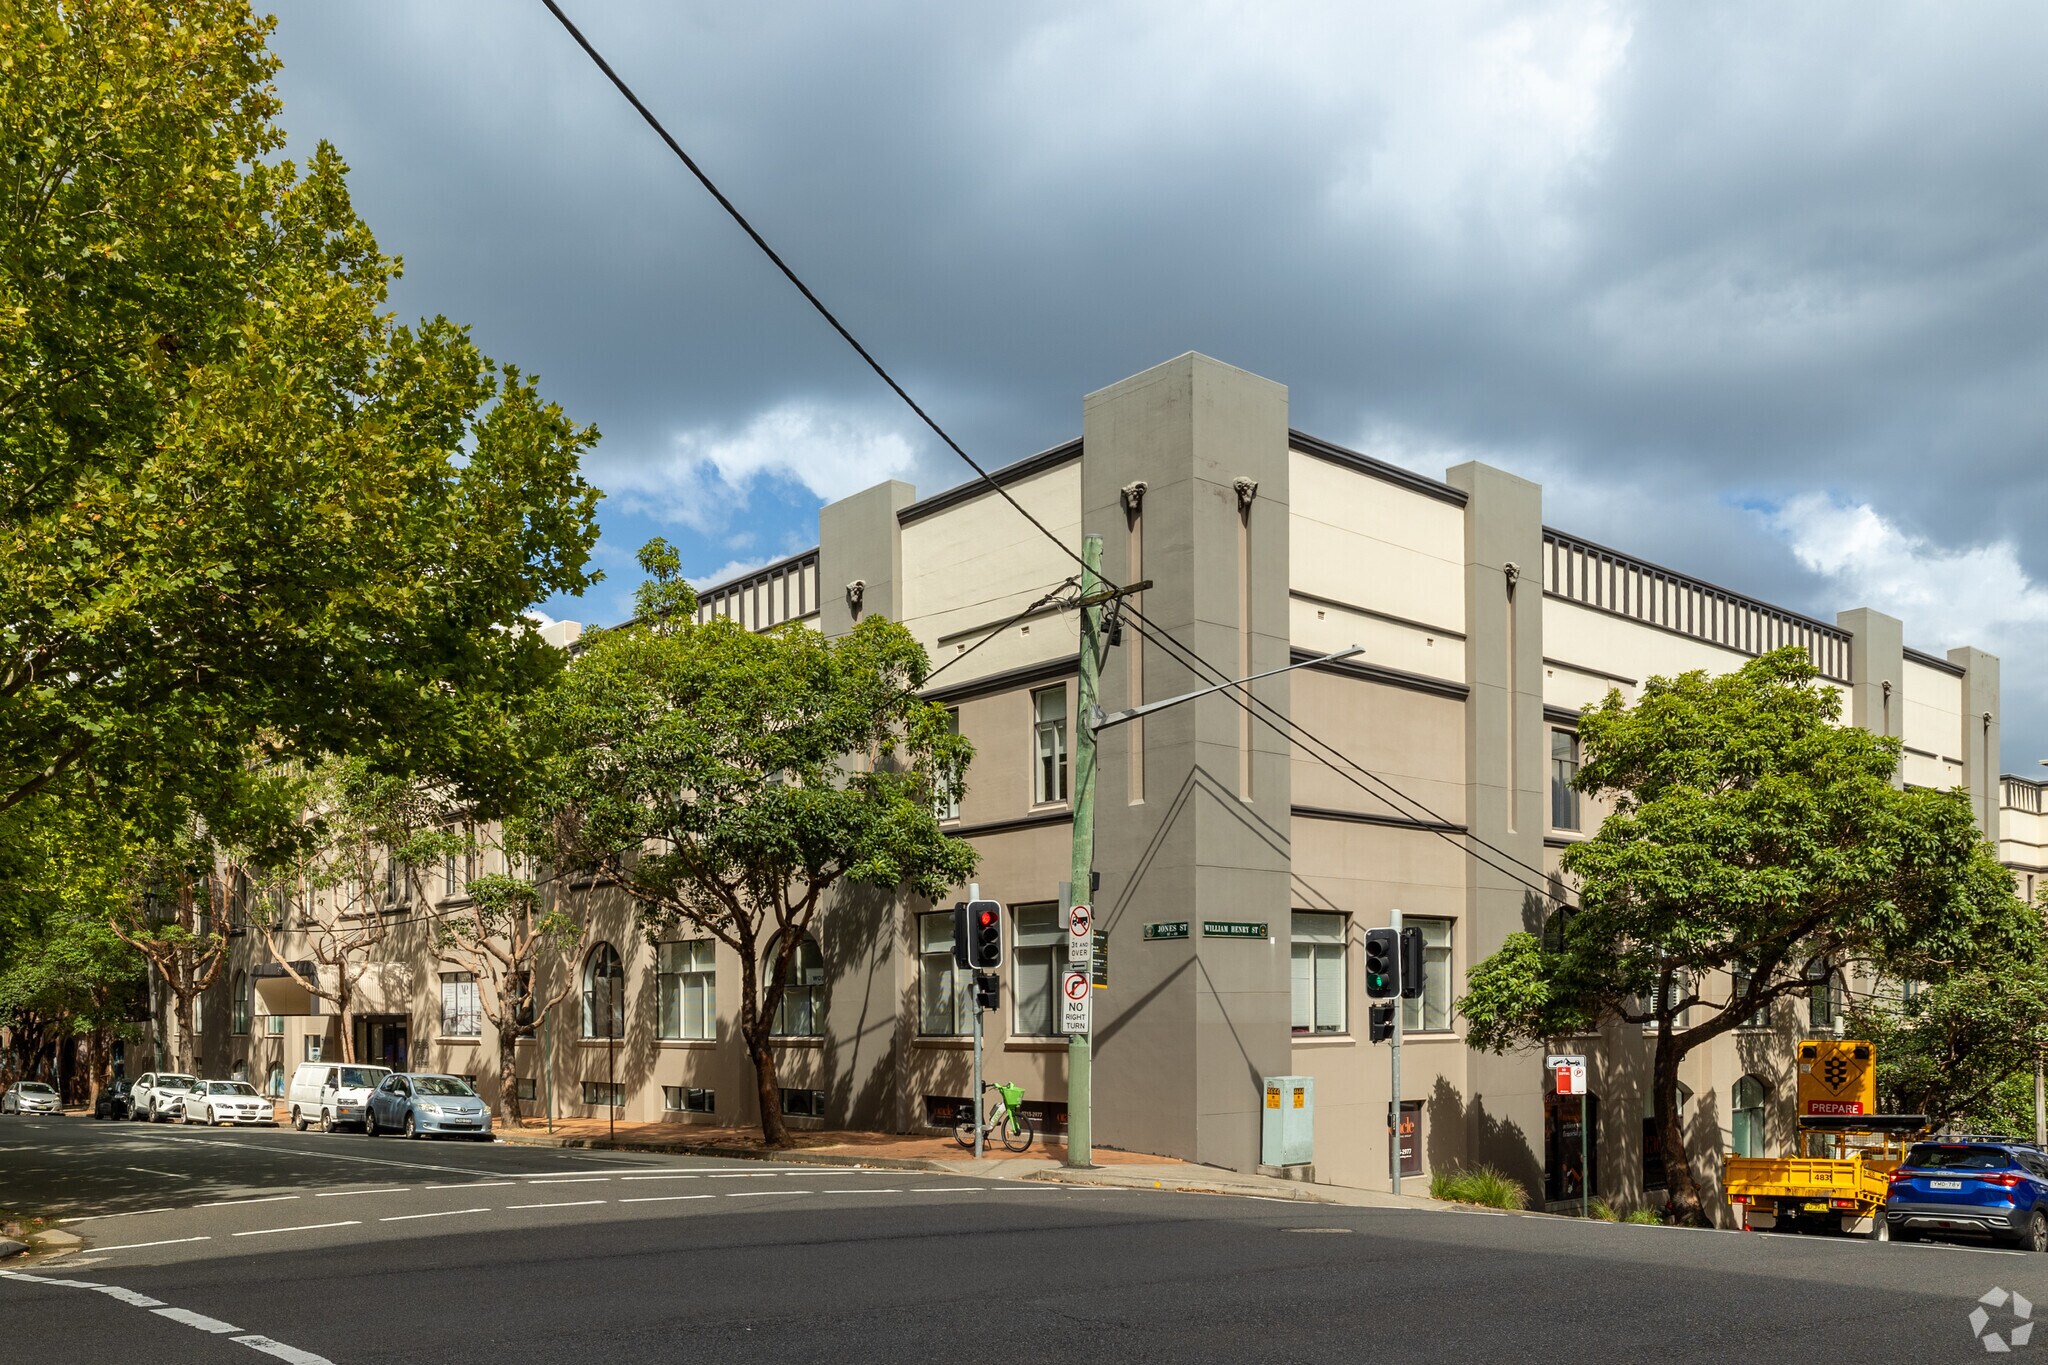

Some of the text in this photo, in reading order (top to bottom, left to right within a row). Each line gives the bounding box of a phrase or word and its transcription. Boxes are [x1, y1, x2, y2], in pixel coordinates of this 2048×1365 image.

[1157, 923, 1188, 933] JONES ST
[1204, 924, 1259, 934] WILLIAM HENRY ST
[1071, 949, 1088, 957] OVER
[1068, 1002, 1083, 1012] NO
[1065, 1013, 1086, 1021] RIGHT
[1812, 1103, 1859, 1114] PREPARE
